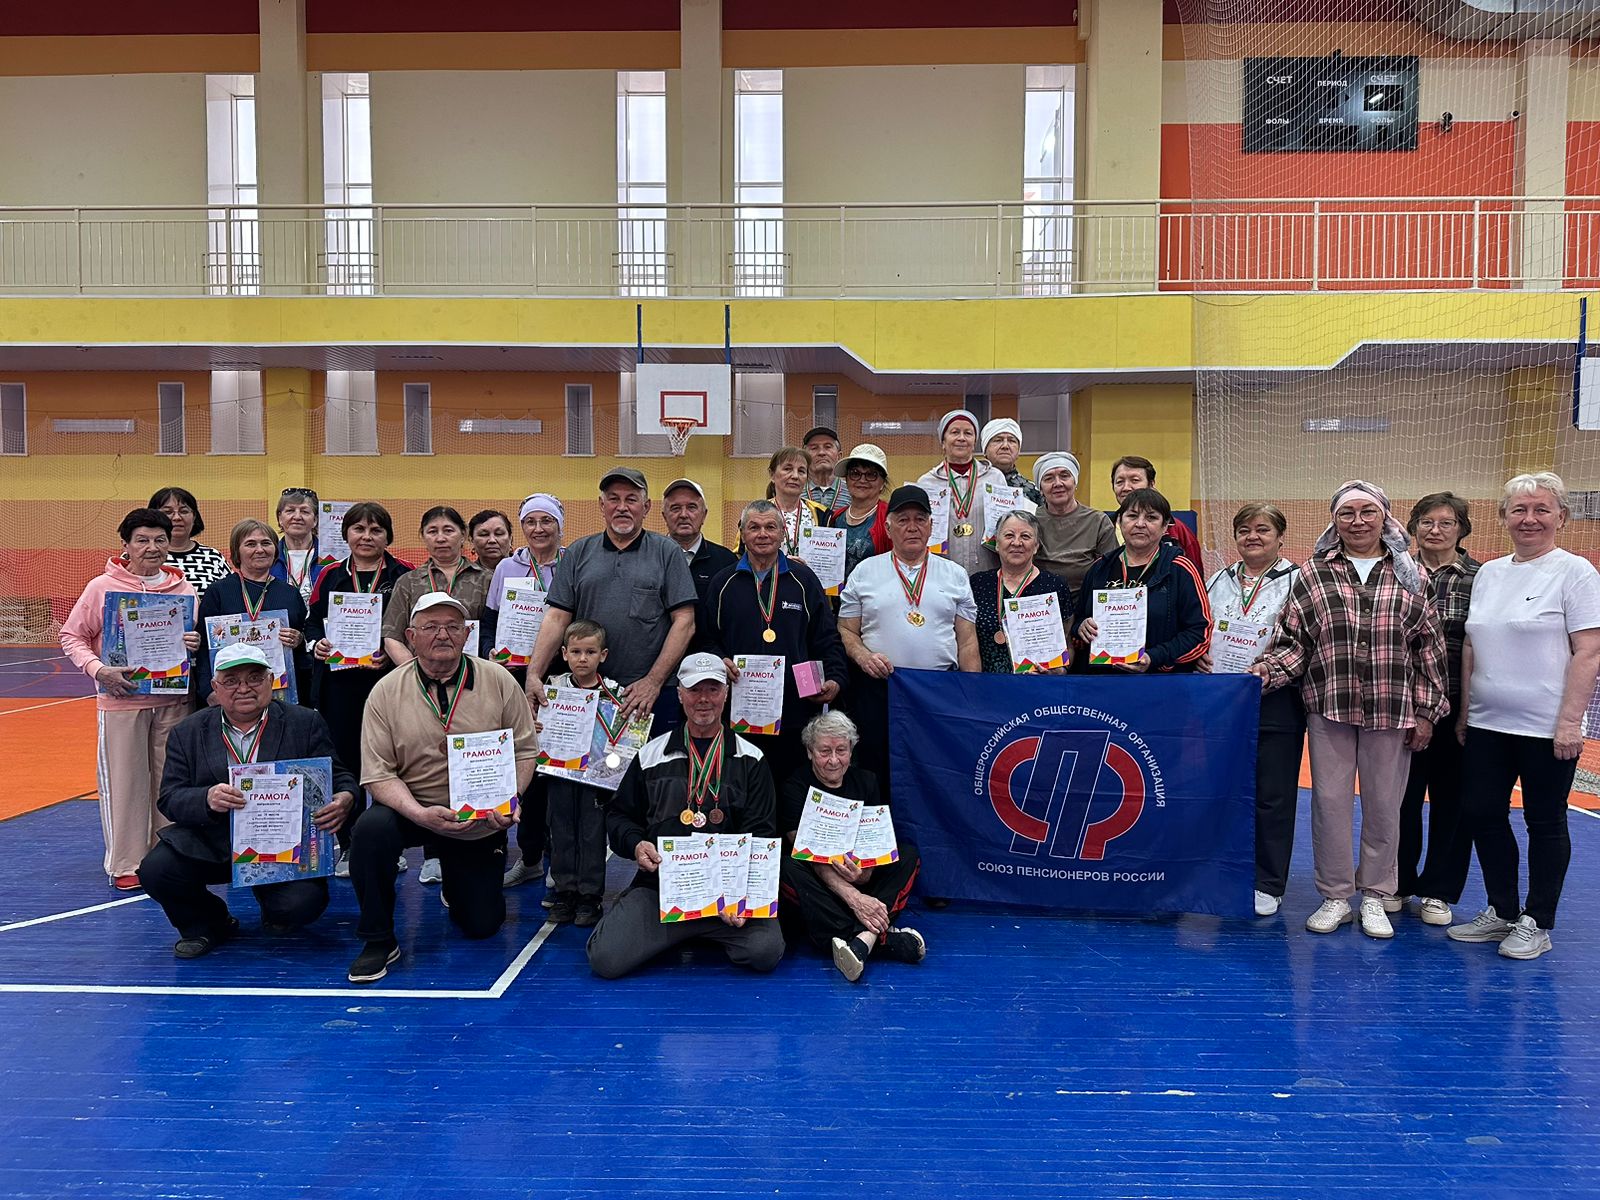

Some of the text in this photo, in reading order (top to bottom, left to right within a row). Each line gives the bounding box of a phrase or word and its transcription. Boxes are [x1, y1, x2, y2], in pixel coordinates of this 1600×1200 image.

[1266, 75, 1293, 84] СЧЕТ
[1370, 74, 1397, 83] СЧЕТ
[1317, 80, 1348, 88] ПЕРИОД
[1265, 117, 1290, 125] ФОЛЫ
[1319, 117, 1344, 125] ВРЕМЯ
[990, 496, 1016, 506] ГРАМОТА
[809, 540, 838, 548] ГРАМОТА
[339, 607, 373, 615] ГРАМОТА
[511, 603, 544, 614] ГРАМОТА
[1104, 603, 1137, 612] ГРАМОТА
[1017, 609, 1050, 620] ГРАМОТА
[136, 619, 173, 630] ГРАМОТА
[1222, 634, 1258, 647] ГРАМОТА
[743, 671, 775, 679] ГРАМОТА
[551, 703, 586, 713] ГРАМОТА
[462, 748, 502, 759] ГРАМОТА
[974, 704, 1166, 808] ОБЩЕРОССИЙСКАЯ ОБЩЕСТВЕННАЯ ОРГАНИЗАЦИЯ
[249, 792, 290, 801] ГРАМОТА
[816, 805, 850, 819] ГРАМОТА
[671, 852, 709, 861] ГРАМОТА
[977, 861, 1165, 882] СОЮЗ ПЕНСИОНЕРОВ РОССИИ
